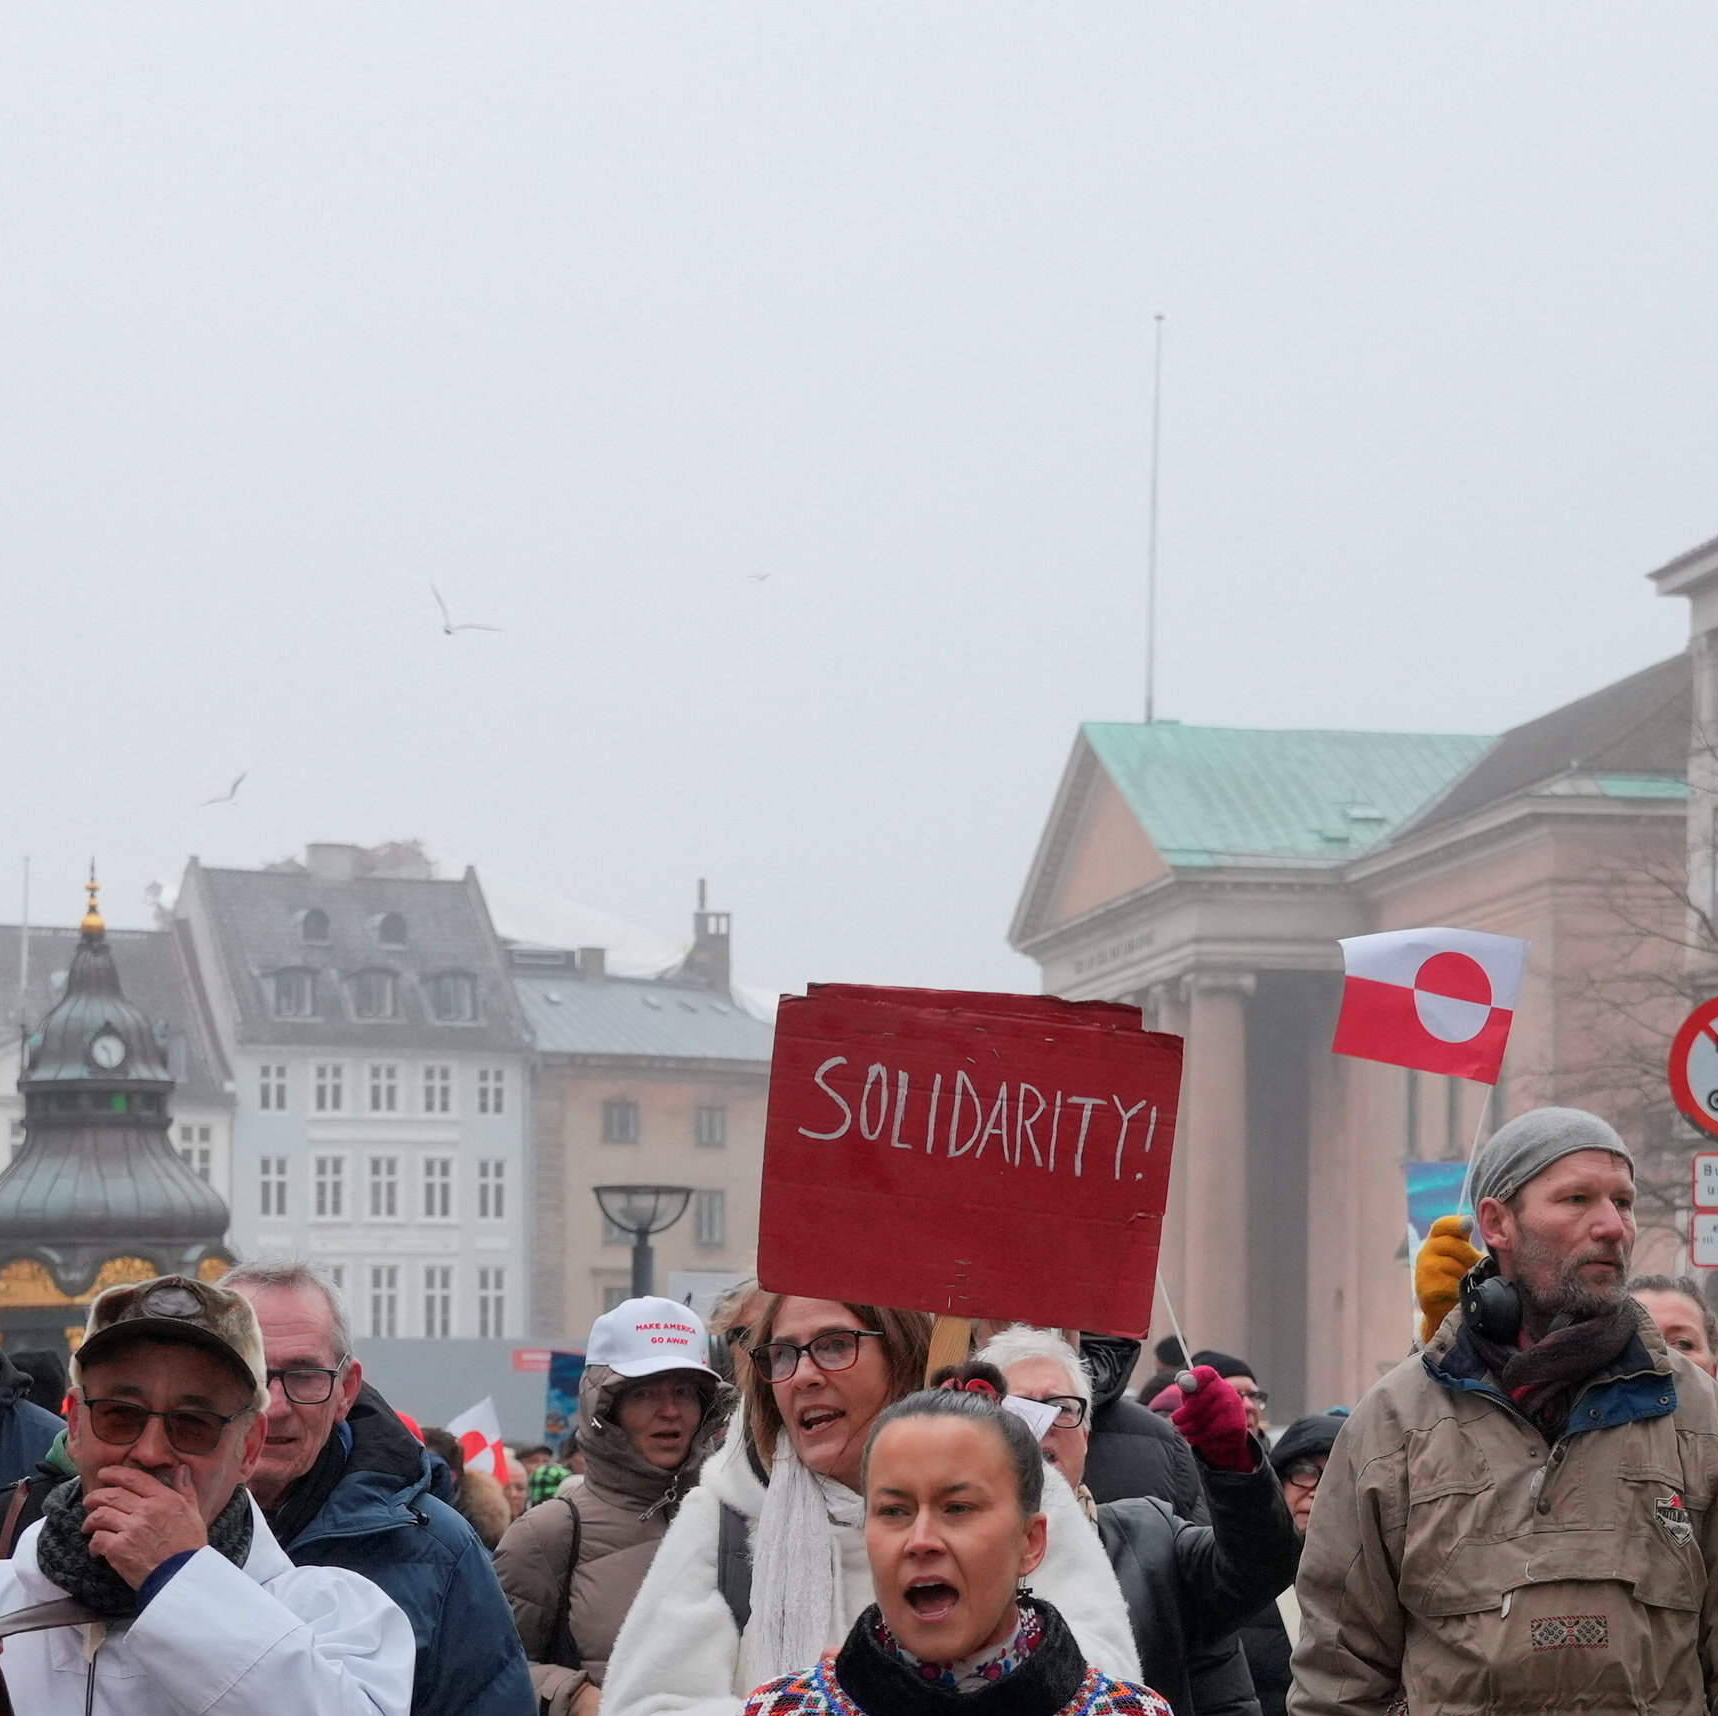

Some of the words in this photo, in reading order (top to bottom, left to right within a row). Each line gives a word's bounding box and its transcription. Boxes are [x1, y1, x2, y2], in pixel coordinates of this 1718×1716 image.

[797, 1055, 1158, 1182] SOLIDARITY!
[635, 1323, 661, 1331] MAKE
[663, 1323, 696, 1335] AMERICA
[667, 1337, 689, 1345] AWAY
